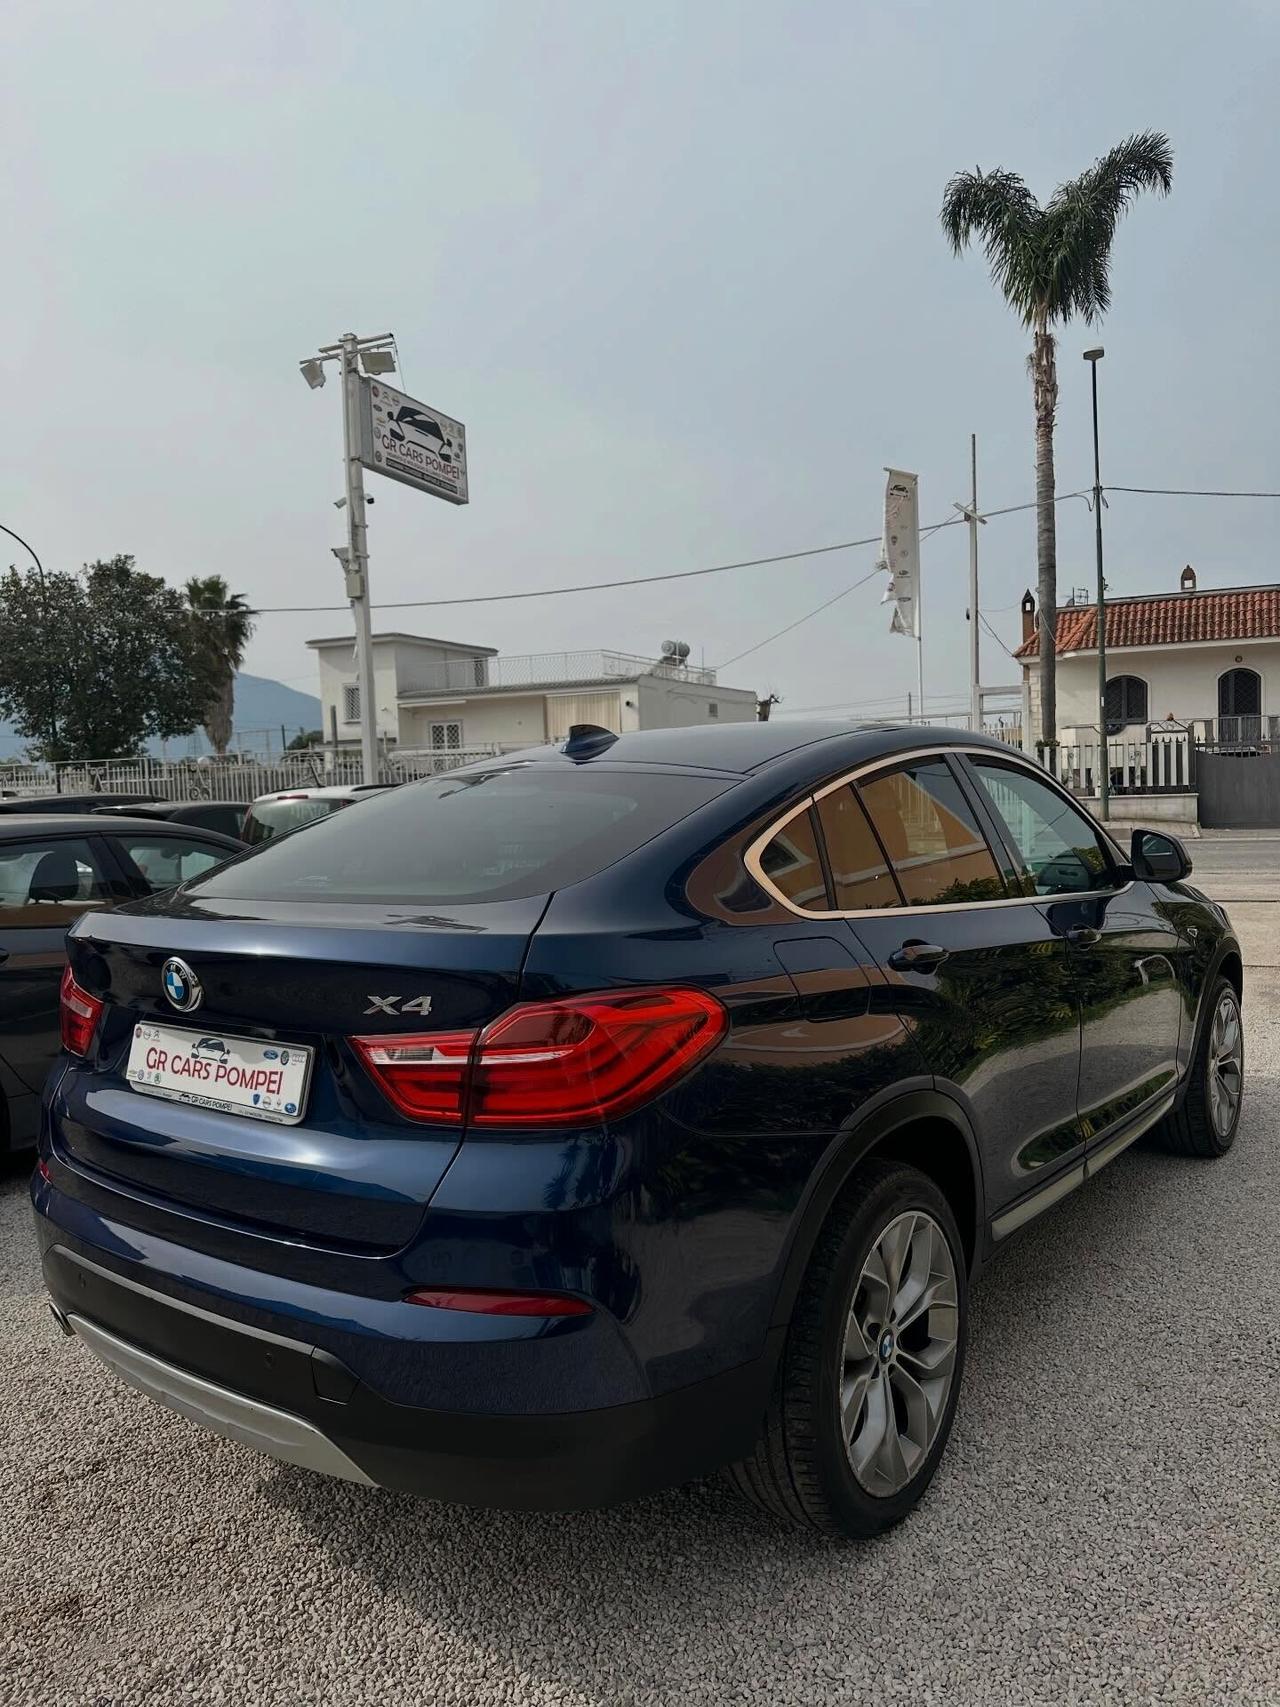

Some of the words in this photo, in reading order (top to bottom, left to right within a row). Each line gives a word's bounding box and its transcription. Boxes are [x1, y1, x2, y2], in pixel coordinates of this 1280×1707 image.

[382, 434, 397, 453] GR
[399, 443, 424, 464] CARS
[426, 455, 460, 480] POMPEI
[362, 996, 432, 1015] X4
[146, 1047, 168, 1072] GR
[171, 1055, 212, 1080] CARS
[215, 1064, 284, 1095] POMPEI
[191, 1095, 200, 1104] GR
[200, 1097, 212, 1107] CARS
[212, 1101, 233, 1111] POMPEI
